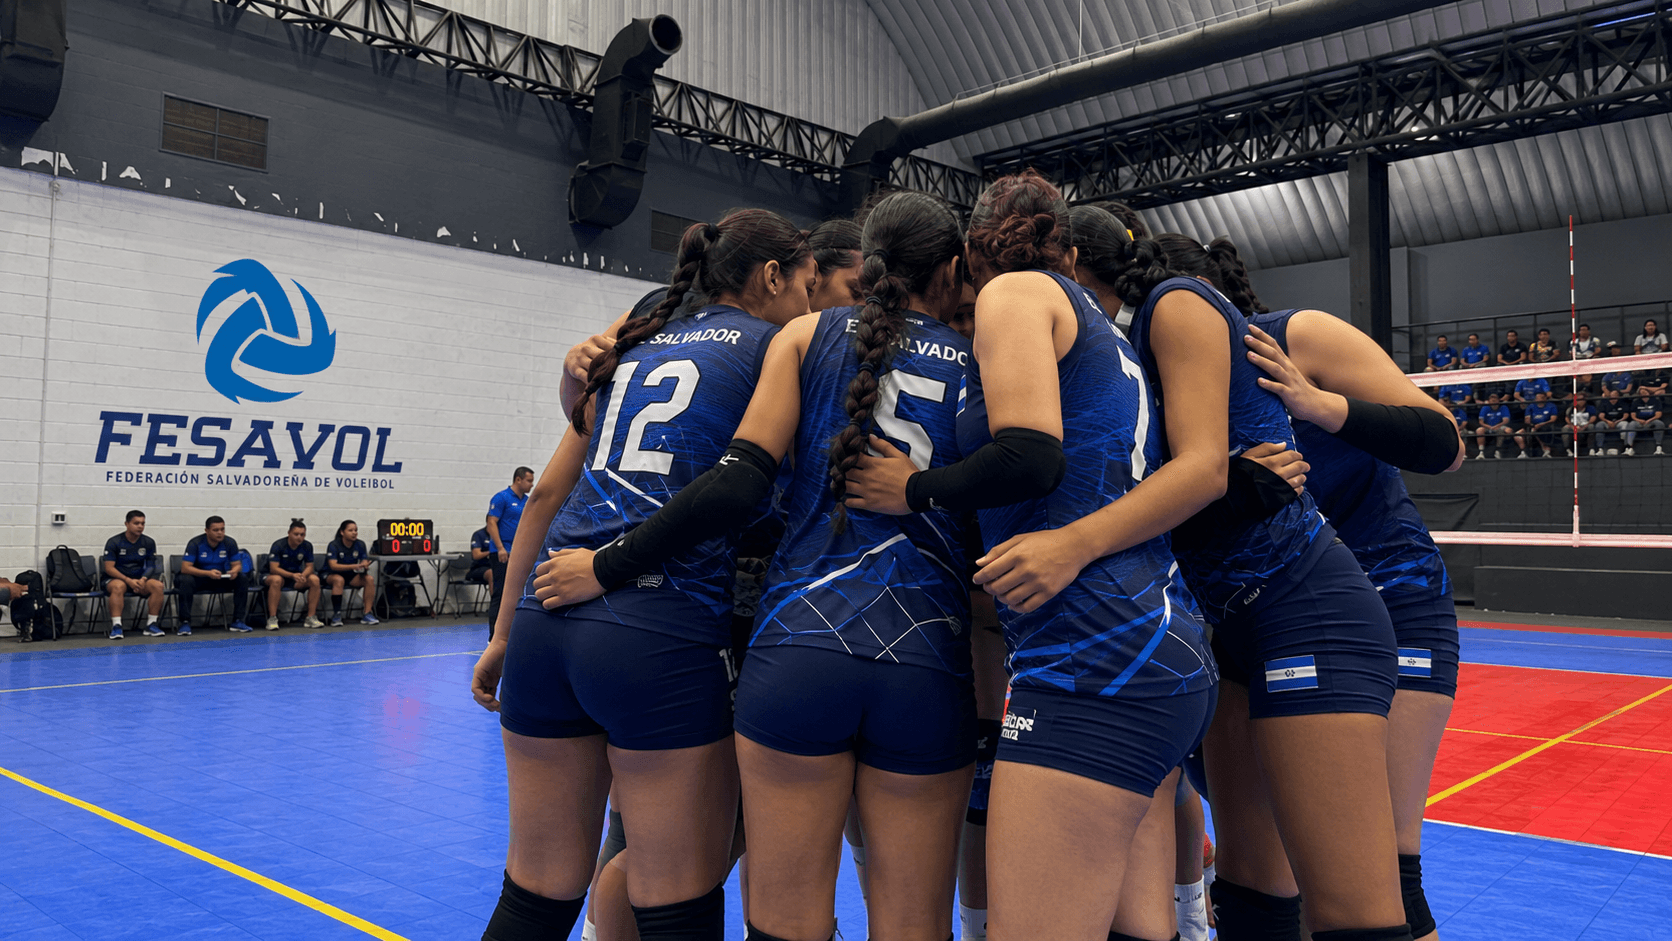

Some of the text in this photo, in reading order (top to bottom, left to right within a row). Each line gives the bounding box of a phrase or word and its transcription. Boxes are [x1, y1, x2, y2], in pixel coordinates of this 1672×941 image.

[845, 318, 860, 333] E
[649, 328, 742, 345] SALVADOR
[590, 359, 701, 476] 12
[871, 367, 947, 471] 5
[1116, 345, 1150, 482] 7
[95, 410, 403, 474] FESAVOL
[106, 470, 395, 490] FEDERACIÓN SALVADOREÑA DE VOLEIBOL
[390, 522, 424, 536] 00:00
[392, 539, 431, 553] 0 0
